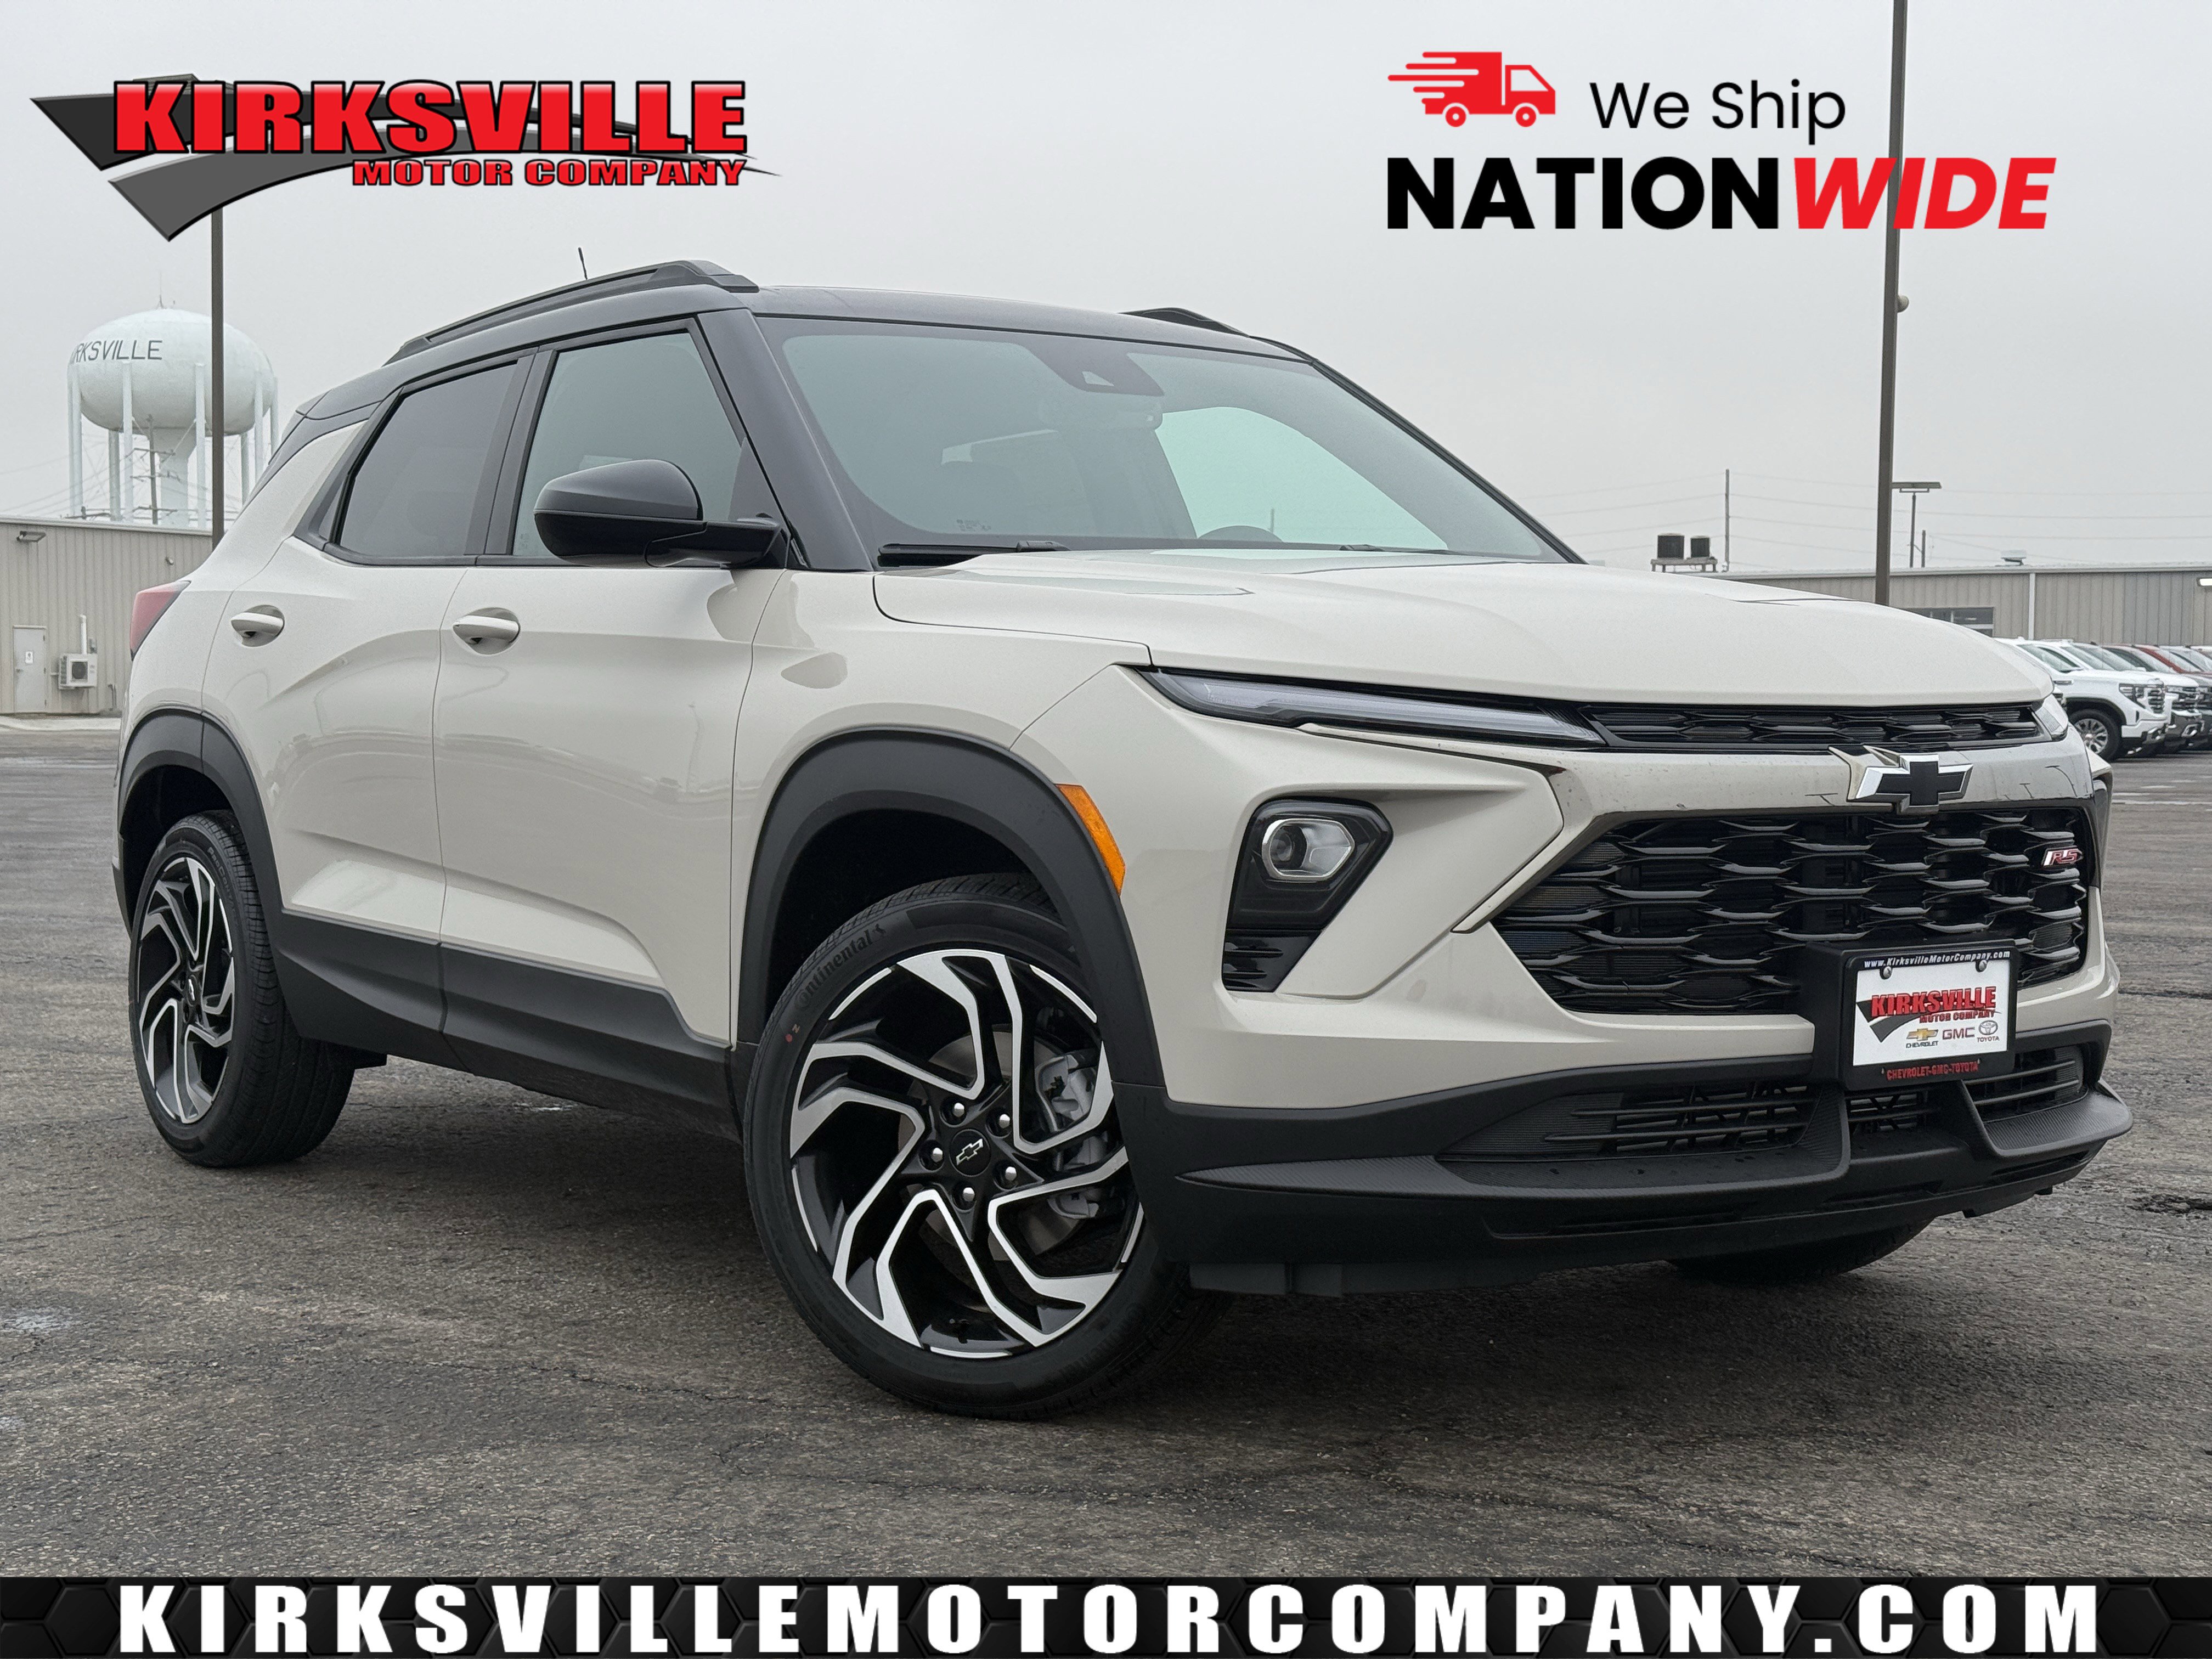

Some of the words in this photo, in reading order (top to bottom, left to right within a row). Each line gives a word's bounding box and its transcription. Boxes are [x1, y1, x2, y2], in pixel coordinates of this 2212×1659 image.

[2043, 848, 2078, 866] RS
[1864, 951, 2011, 968] www.KirksvilleMotorCompany.com
[795, 930, 873, 1008] Continental
[1871, 986, 1996, 1017] KIRKSVILLE
[1920, 1012, 1951, 1024] MOTOR
[1953, 1009, 1996, 1021] COMPANY
[1942, 1027, 1975, 1040] GMC
